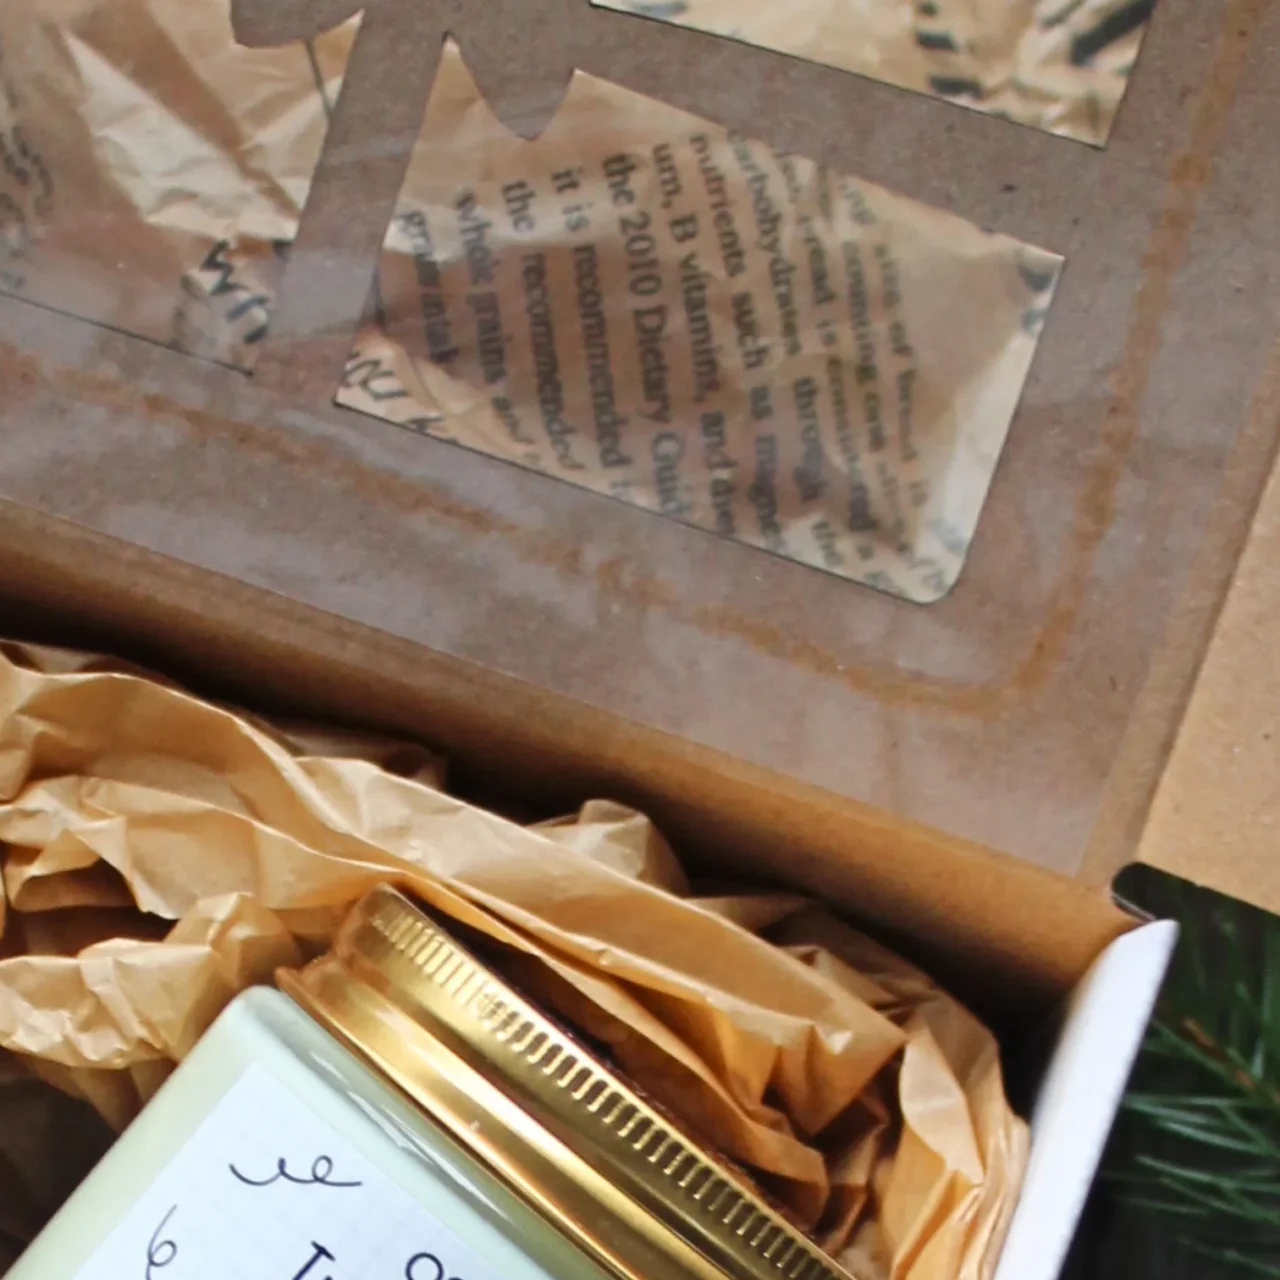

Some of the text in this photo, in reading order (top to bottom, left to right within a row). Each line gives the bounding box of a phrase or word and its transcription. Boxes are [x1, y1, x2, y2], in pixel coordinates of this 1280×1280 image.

[551, 166, 586, 195] it
[562, 202, 596, 233] is
[602, 152, 637, 207] the
[619, 209, 664, 299] 2010
[688, 132, 746, 279] nutrients
[730, 290, 771, 371] such
[727, 128, 804, 356] carbohydrates
[501, 179, 586, 470] the recommended
[573, 243, 633, 469] recommended
[632, 305, 672, 425] Dietary
[670, 212, 699, 244] B
[700, 411, 739, 471] and
